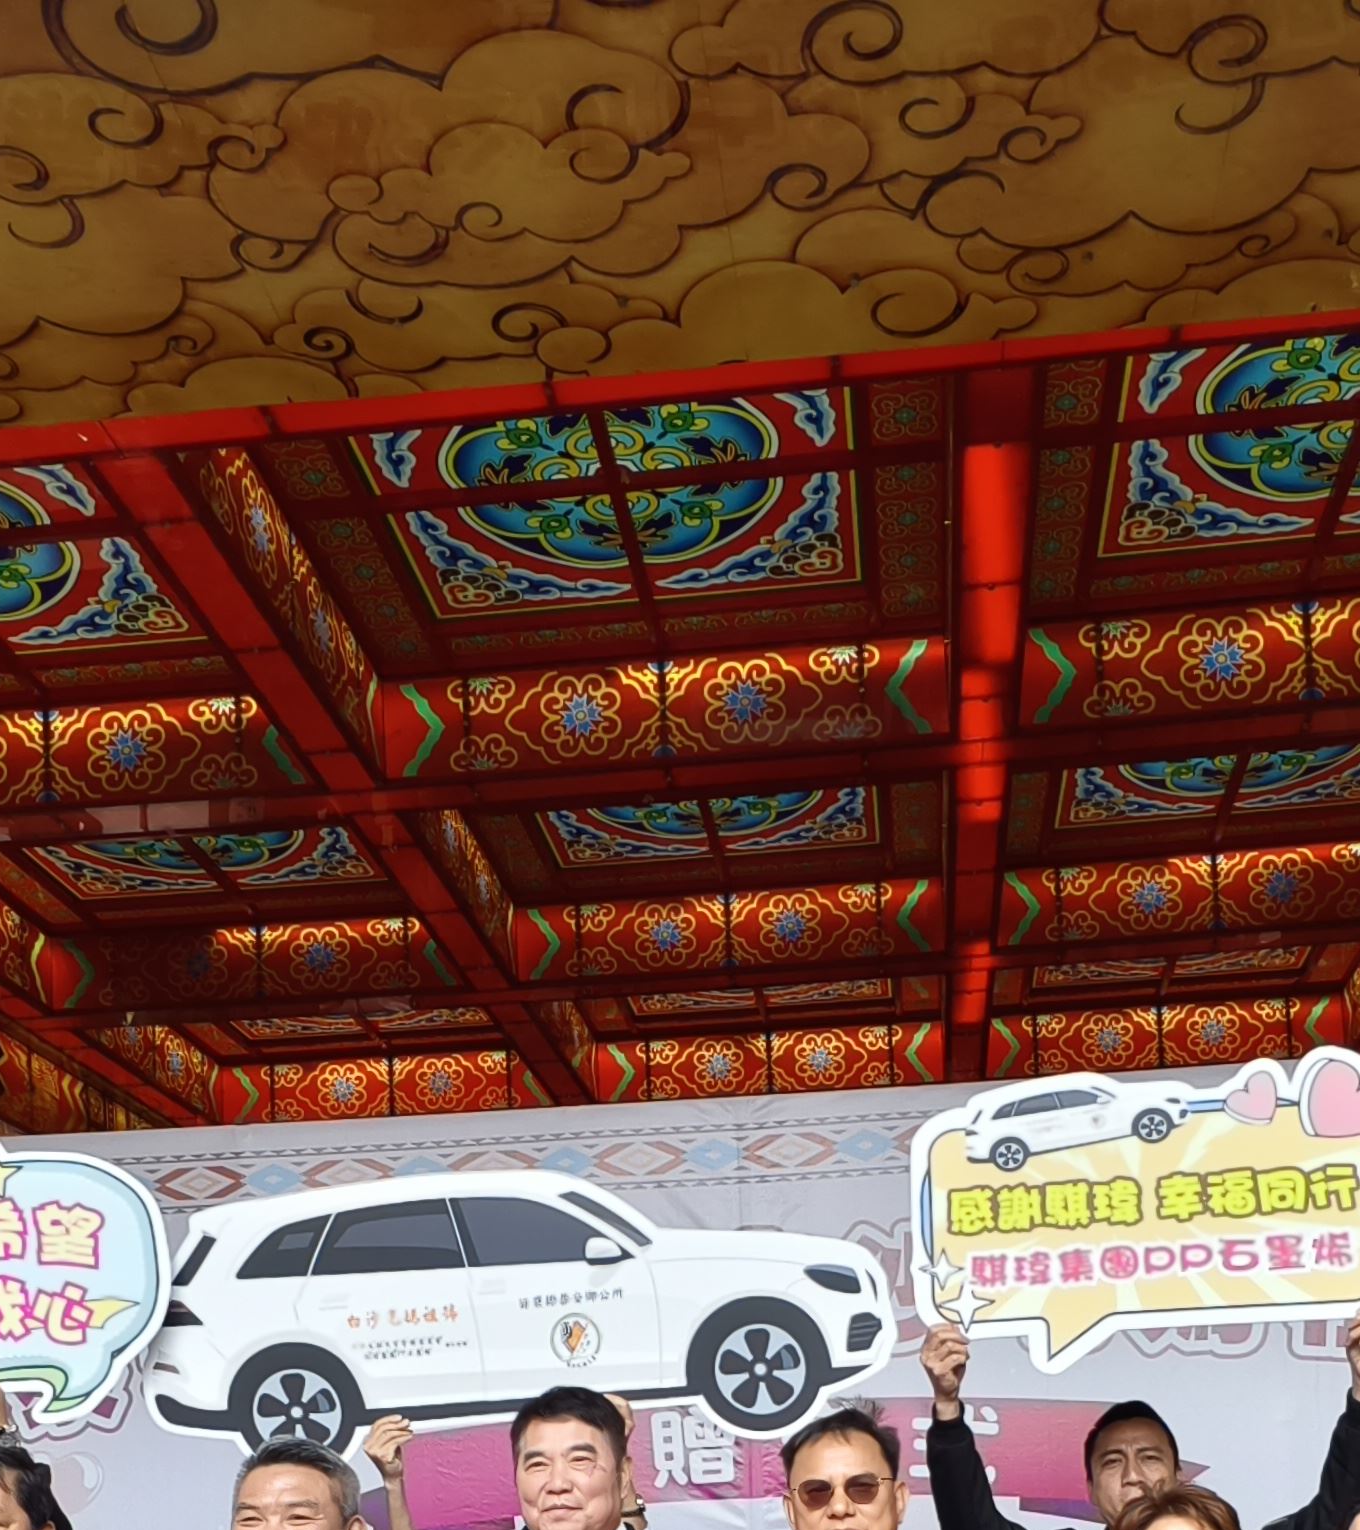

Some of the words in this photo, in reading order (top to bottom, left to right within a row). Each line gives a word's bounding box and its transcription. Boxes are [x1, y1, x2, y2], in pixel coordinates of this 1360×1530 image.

[947, 1176, 1144, 1235] 感謝騏瑋
[1156, 1163, 1360, 1223] 幸福同行
